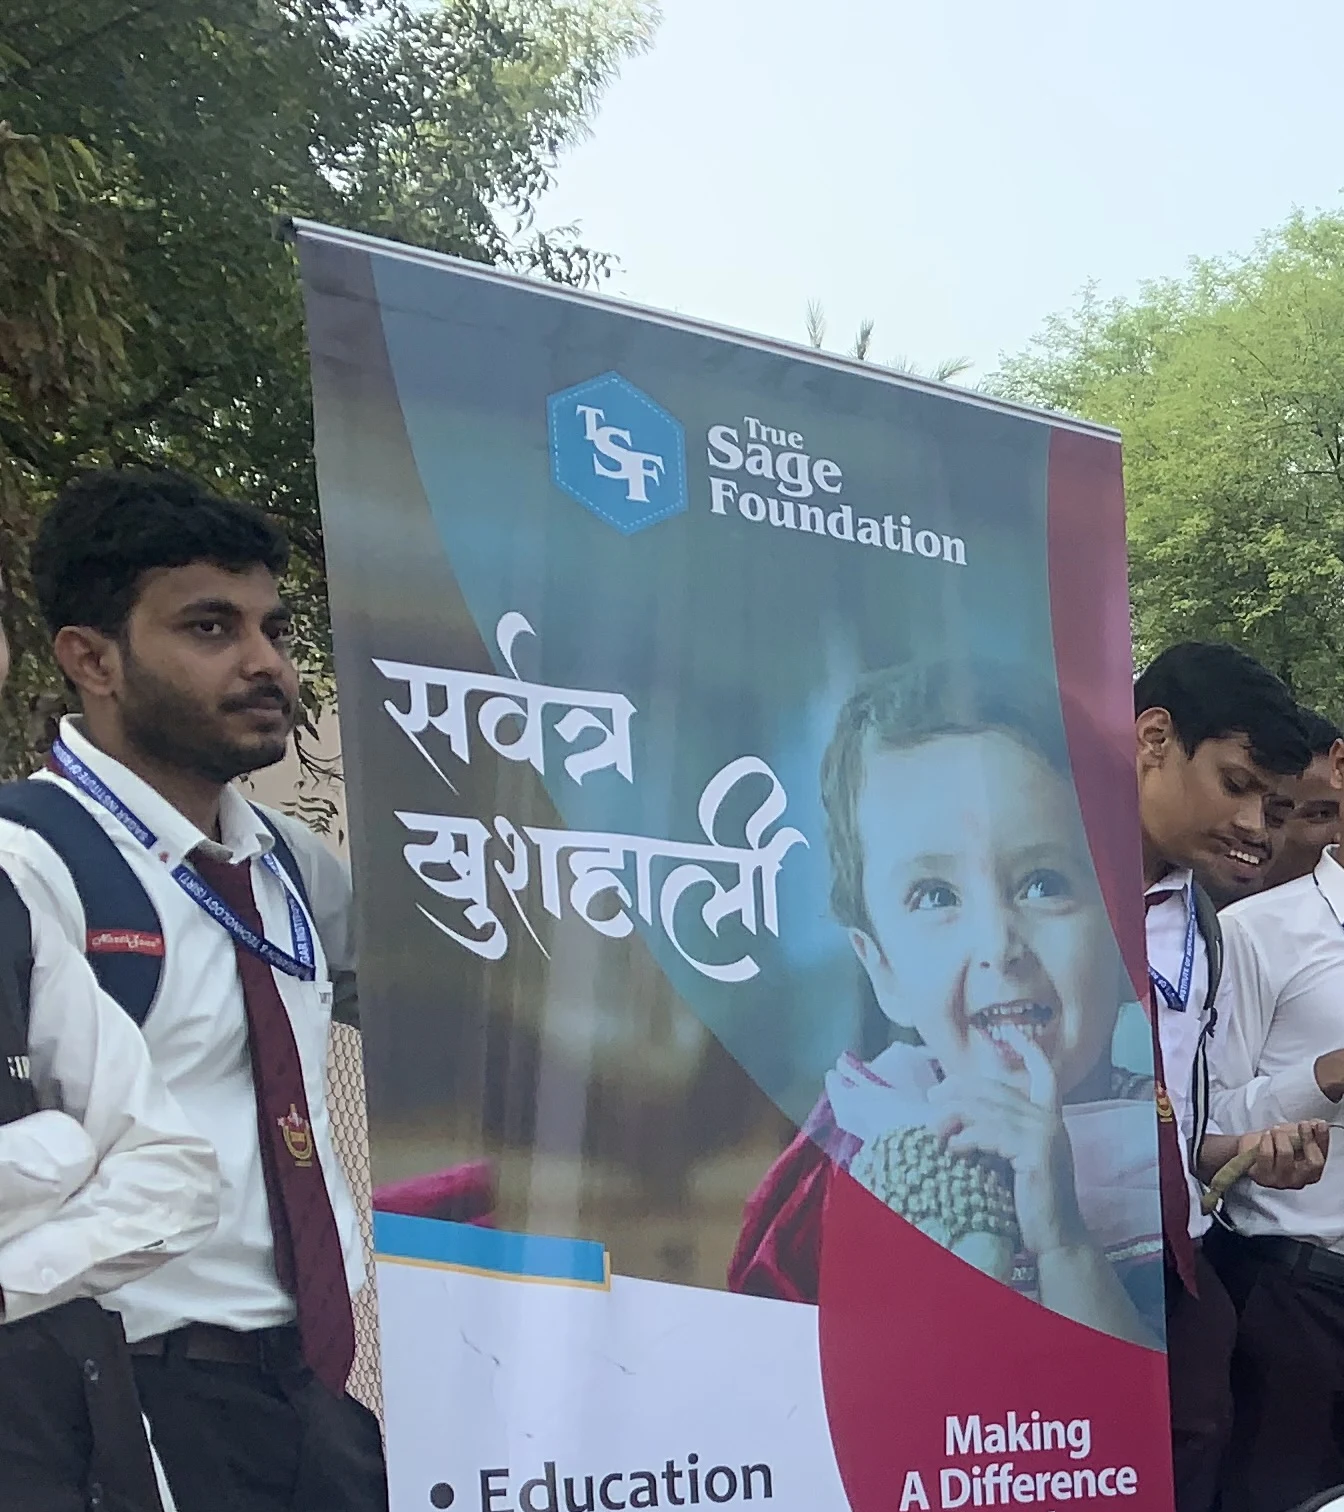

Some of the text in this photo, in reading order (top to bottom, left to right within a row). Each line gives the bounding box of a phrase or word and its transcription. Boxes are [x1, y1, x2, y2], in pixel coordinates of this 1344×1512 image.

[707, 425, 843, 498] Sage
[743, 416, 804, 449] True
[708, 476, 967, 566] Foundation
[371, 611, 637, 796] सर्वत्र
[393, 756, 810, 983] खुशहाली
[945, 1411, 1092, 1458] Making
[900, 1460, 1138, 1512] A Difference
